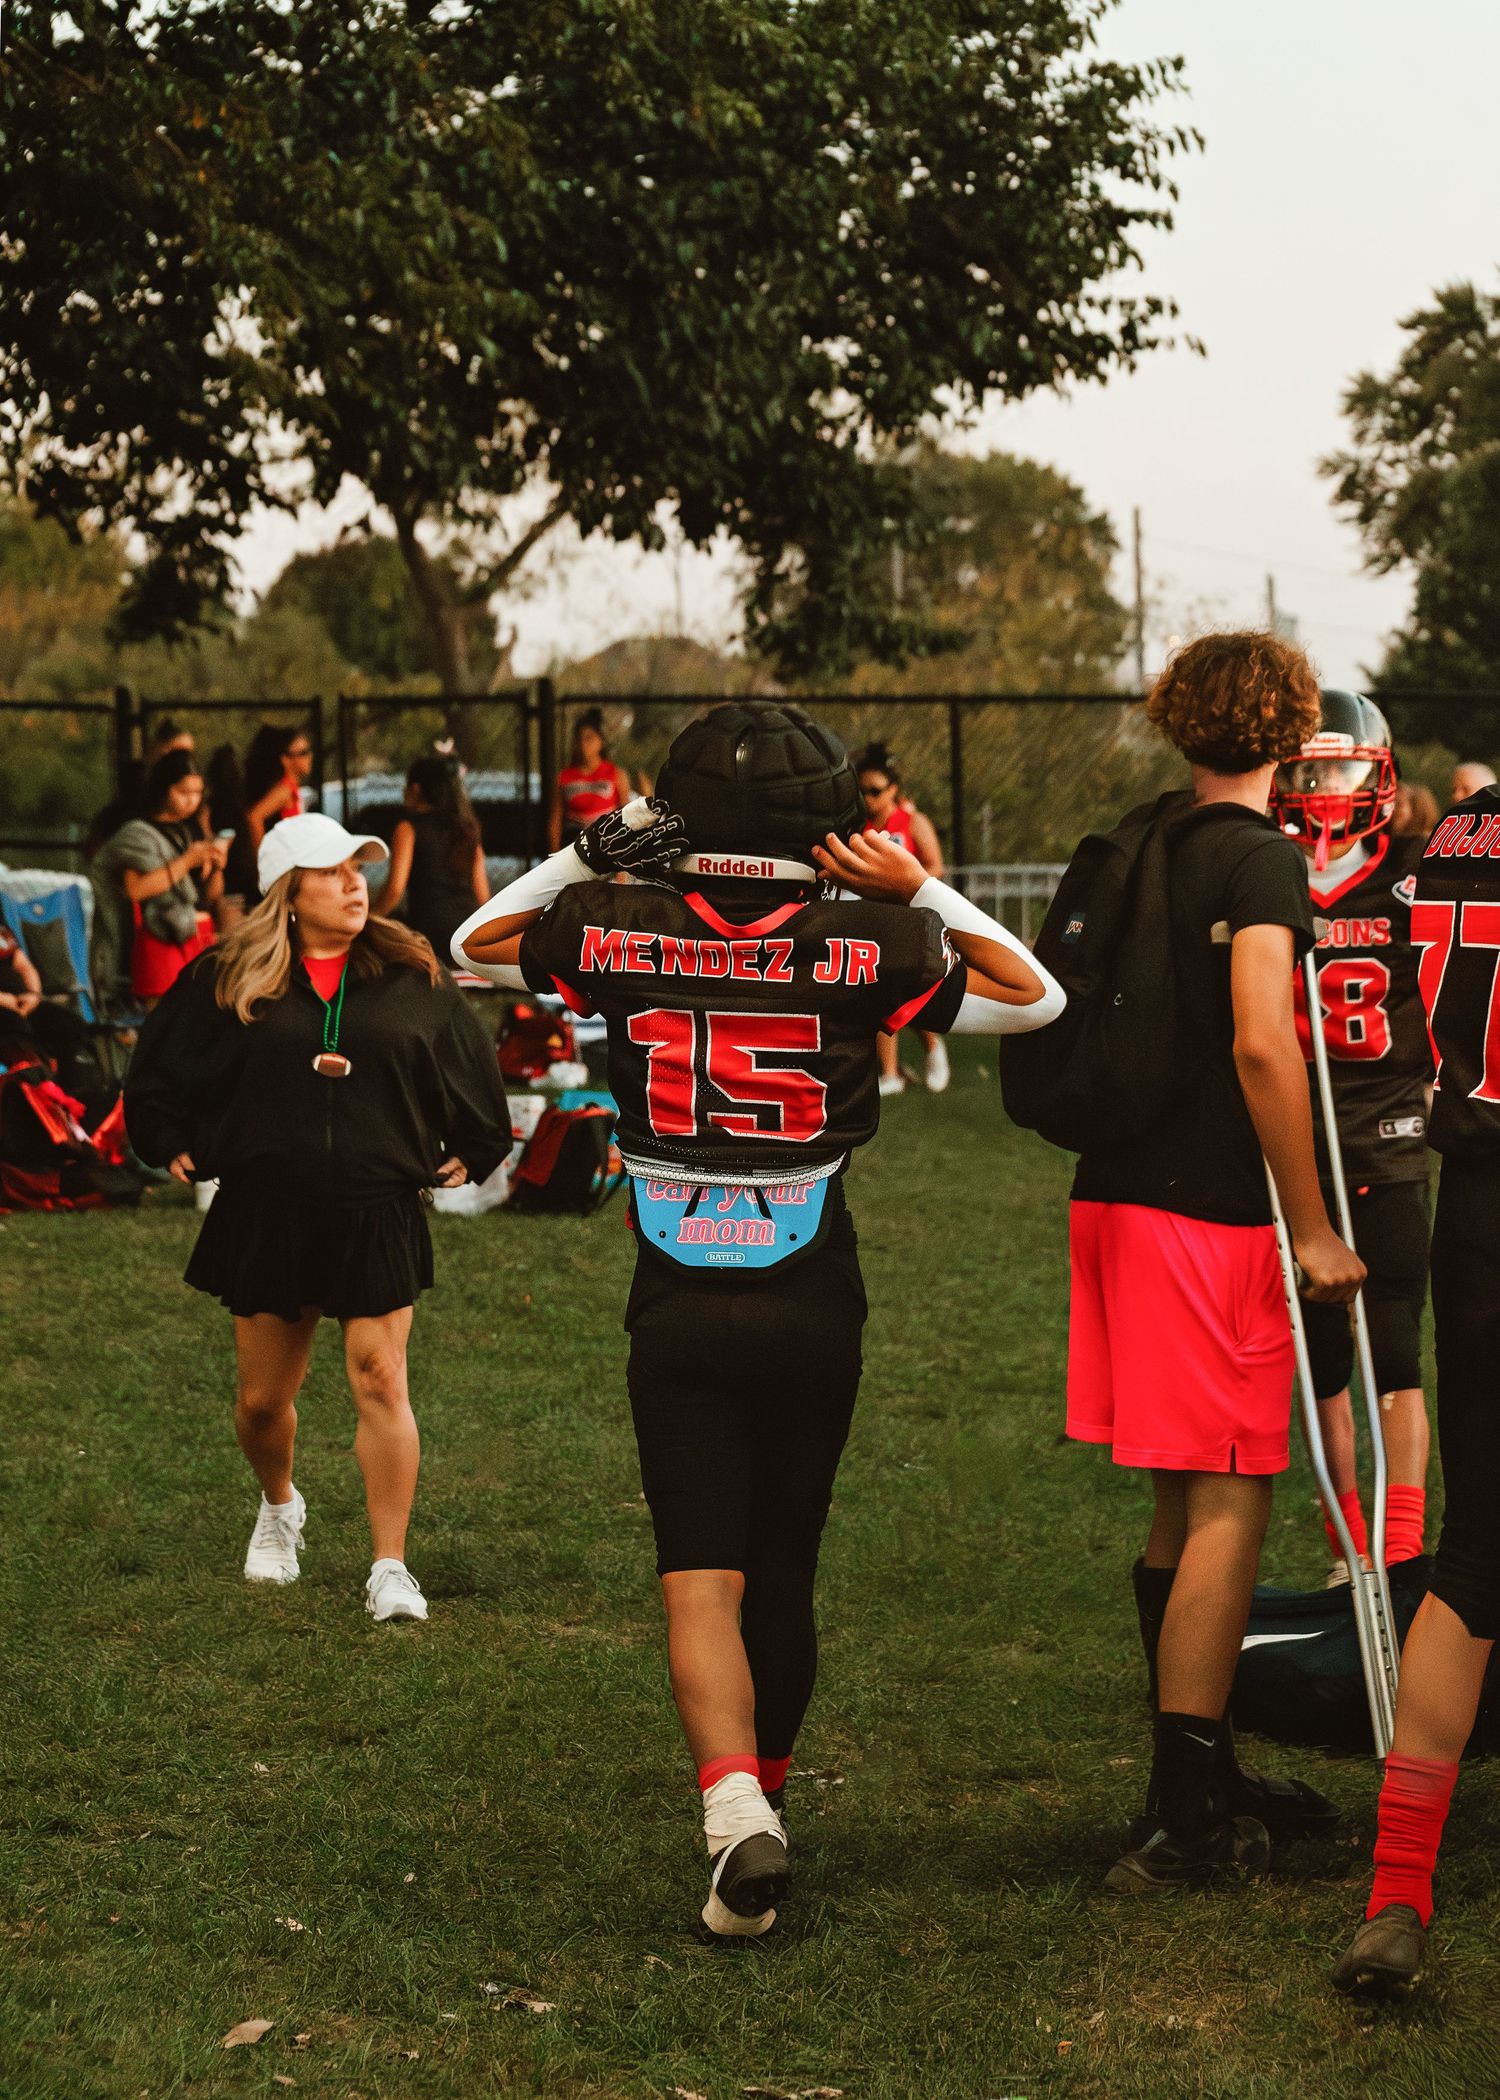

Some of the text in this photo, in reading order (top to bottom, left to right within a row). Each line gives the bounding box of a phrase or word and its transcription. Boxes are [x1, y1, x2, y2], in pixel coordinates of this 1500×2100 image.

[698, 857, 774, 877] Riddell
[579, 925, 880, 985] MENDEZ JR
[1294, 957, 1393, 1062] 8
[627, 1008, 827, 1142] 15
[677, 1217, 777, 1246] mom
[709, 1253, 743, 1261] BATTLE
